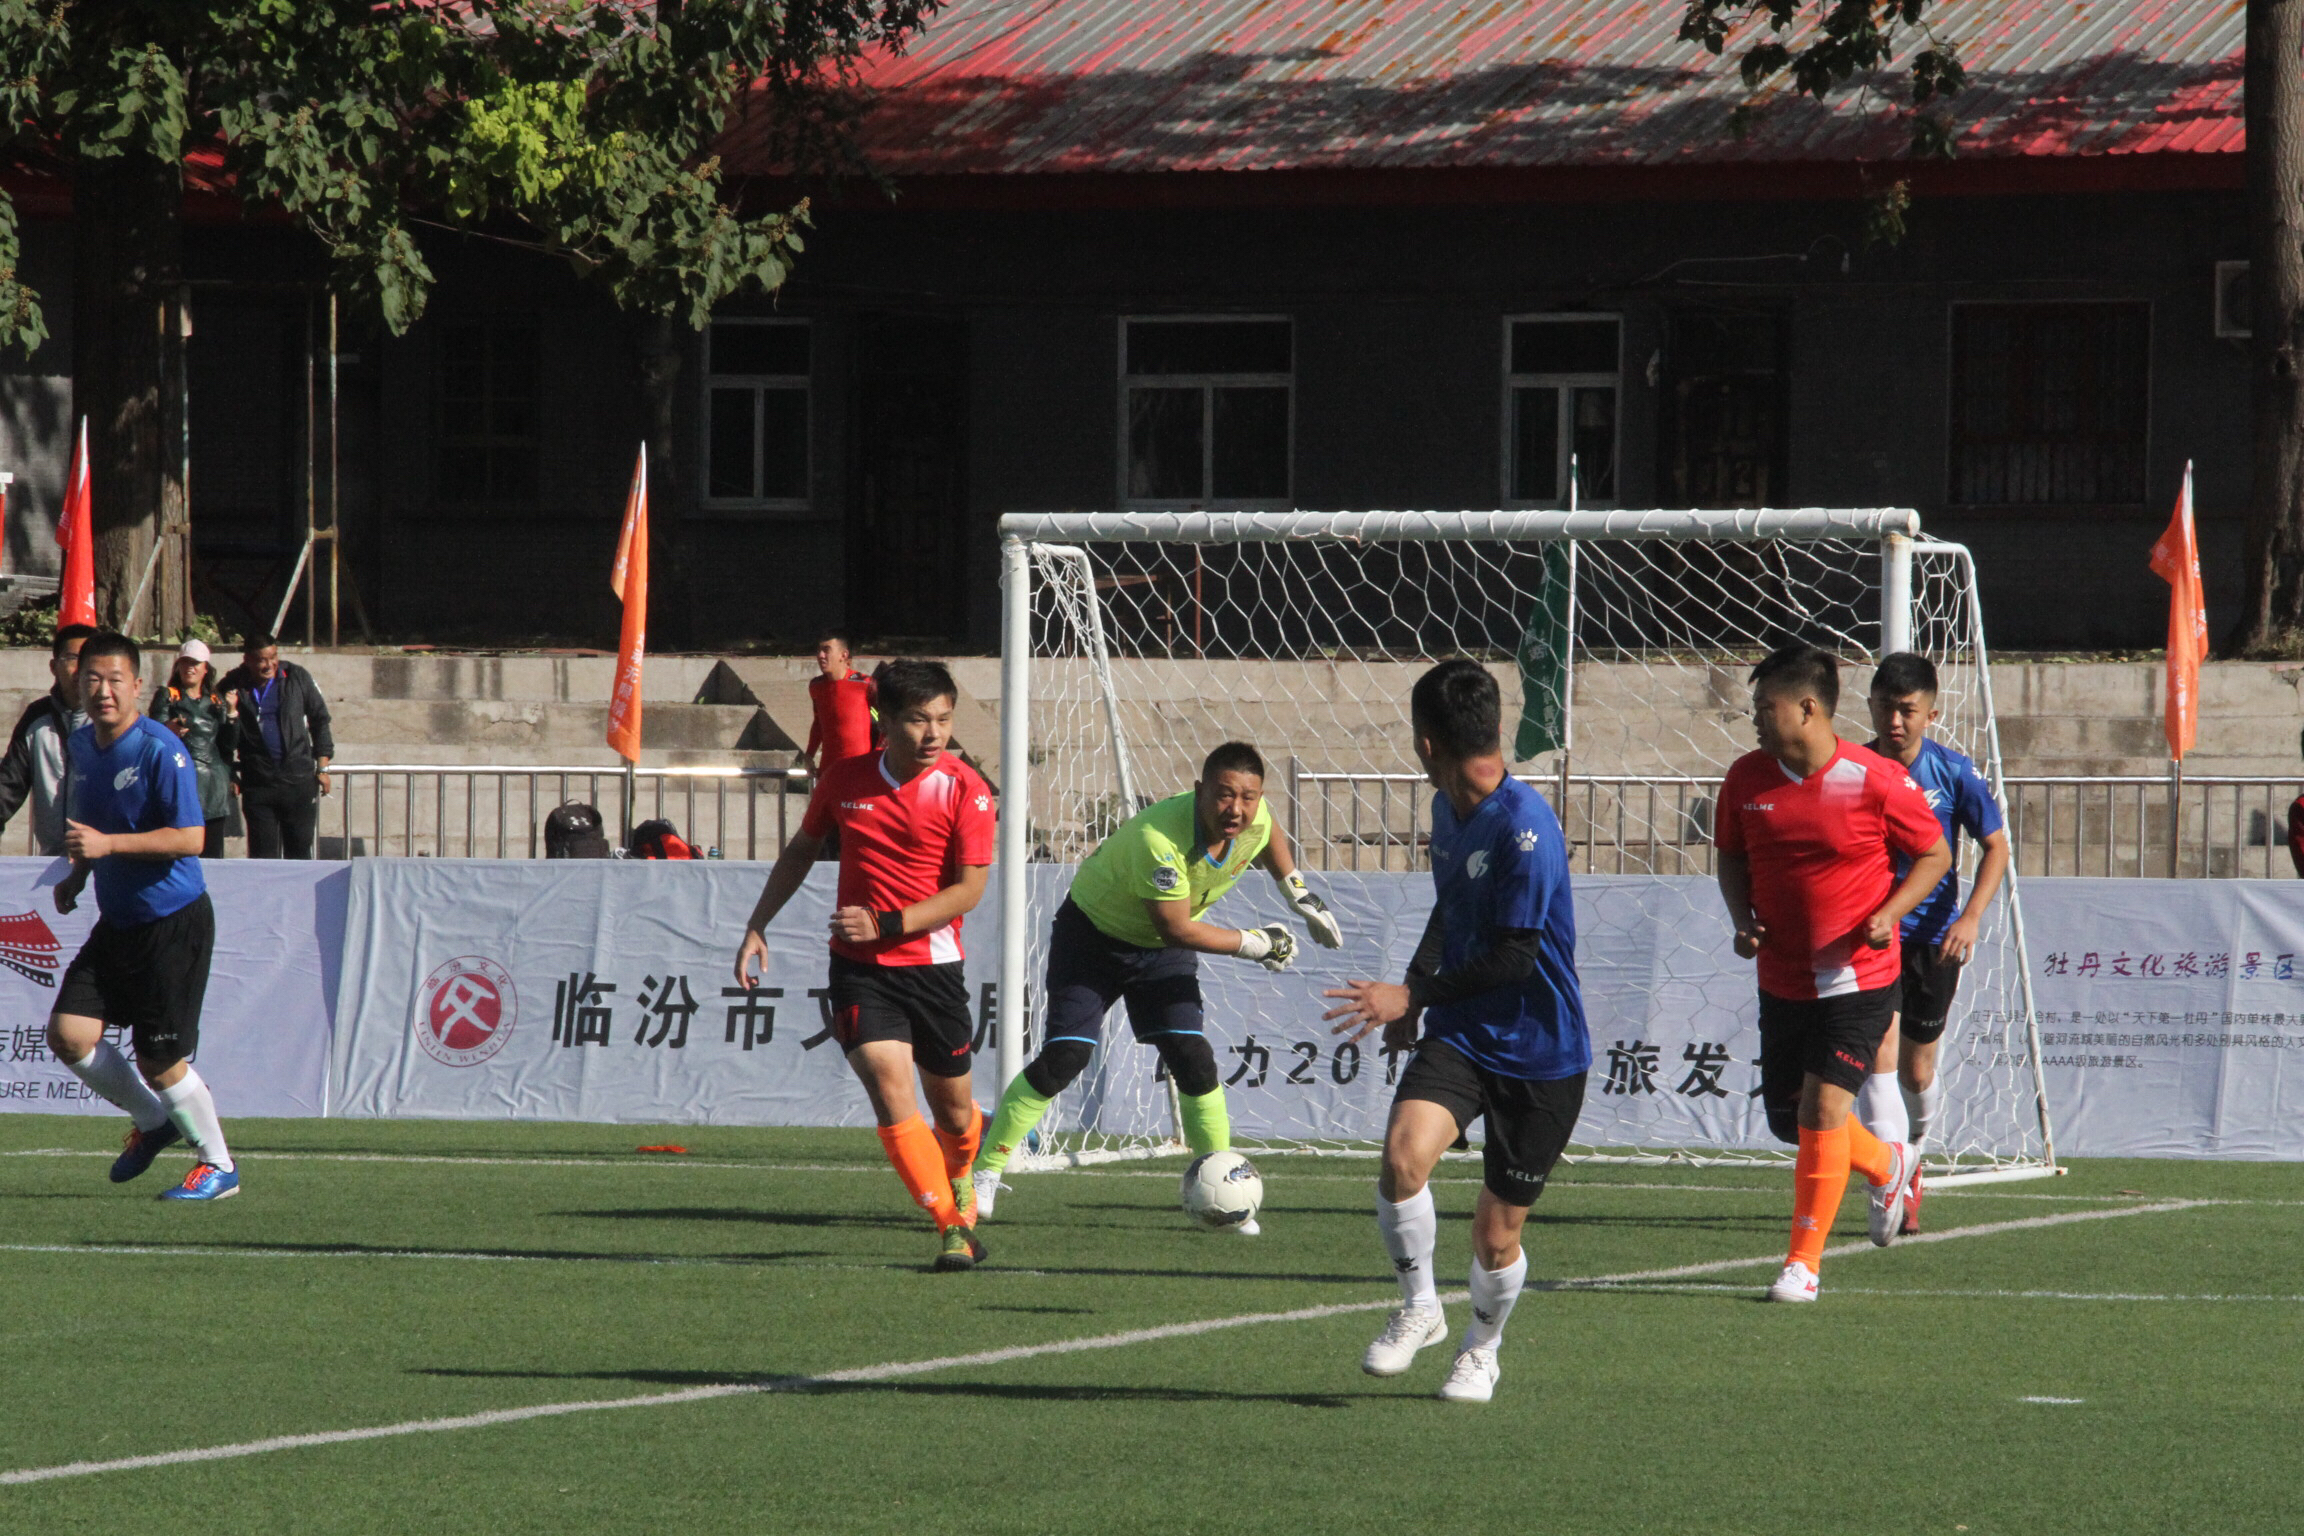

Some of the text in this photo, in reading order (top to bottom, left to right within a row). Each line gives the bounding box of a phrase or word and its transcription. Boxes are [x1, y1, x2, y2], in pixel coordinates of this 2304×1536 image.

[841, 801, 875, 811] KELME
[1743, 802, 1775, 811] KELME
[1201, 888, 1210, 905] 1
[2044, 951, 2294, 980] 牡丹文化旅游景区
[46, 1081, 102, 1099] MED
[1507, 1167, 1546, 1183] KELME
